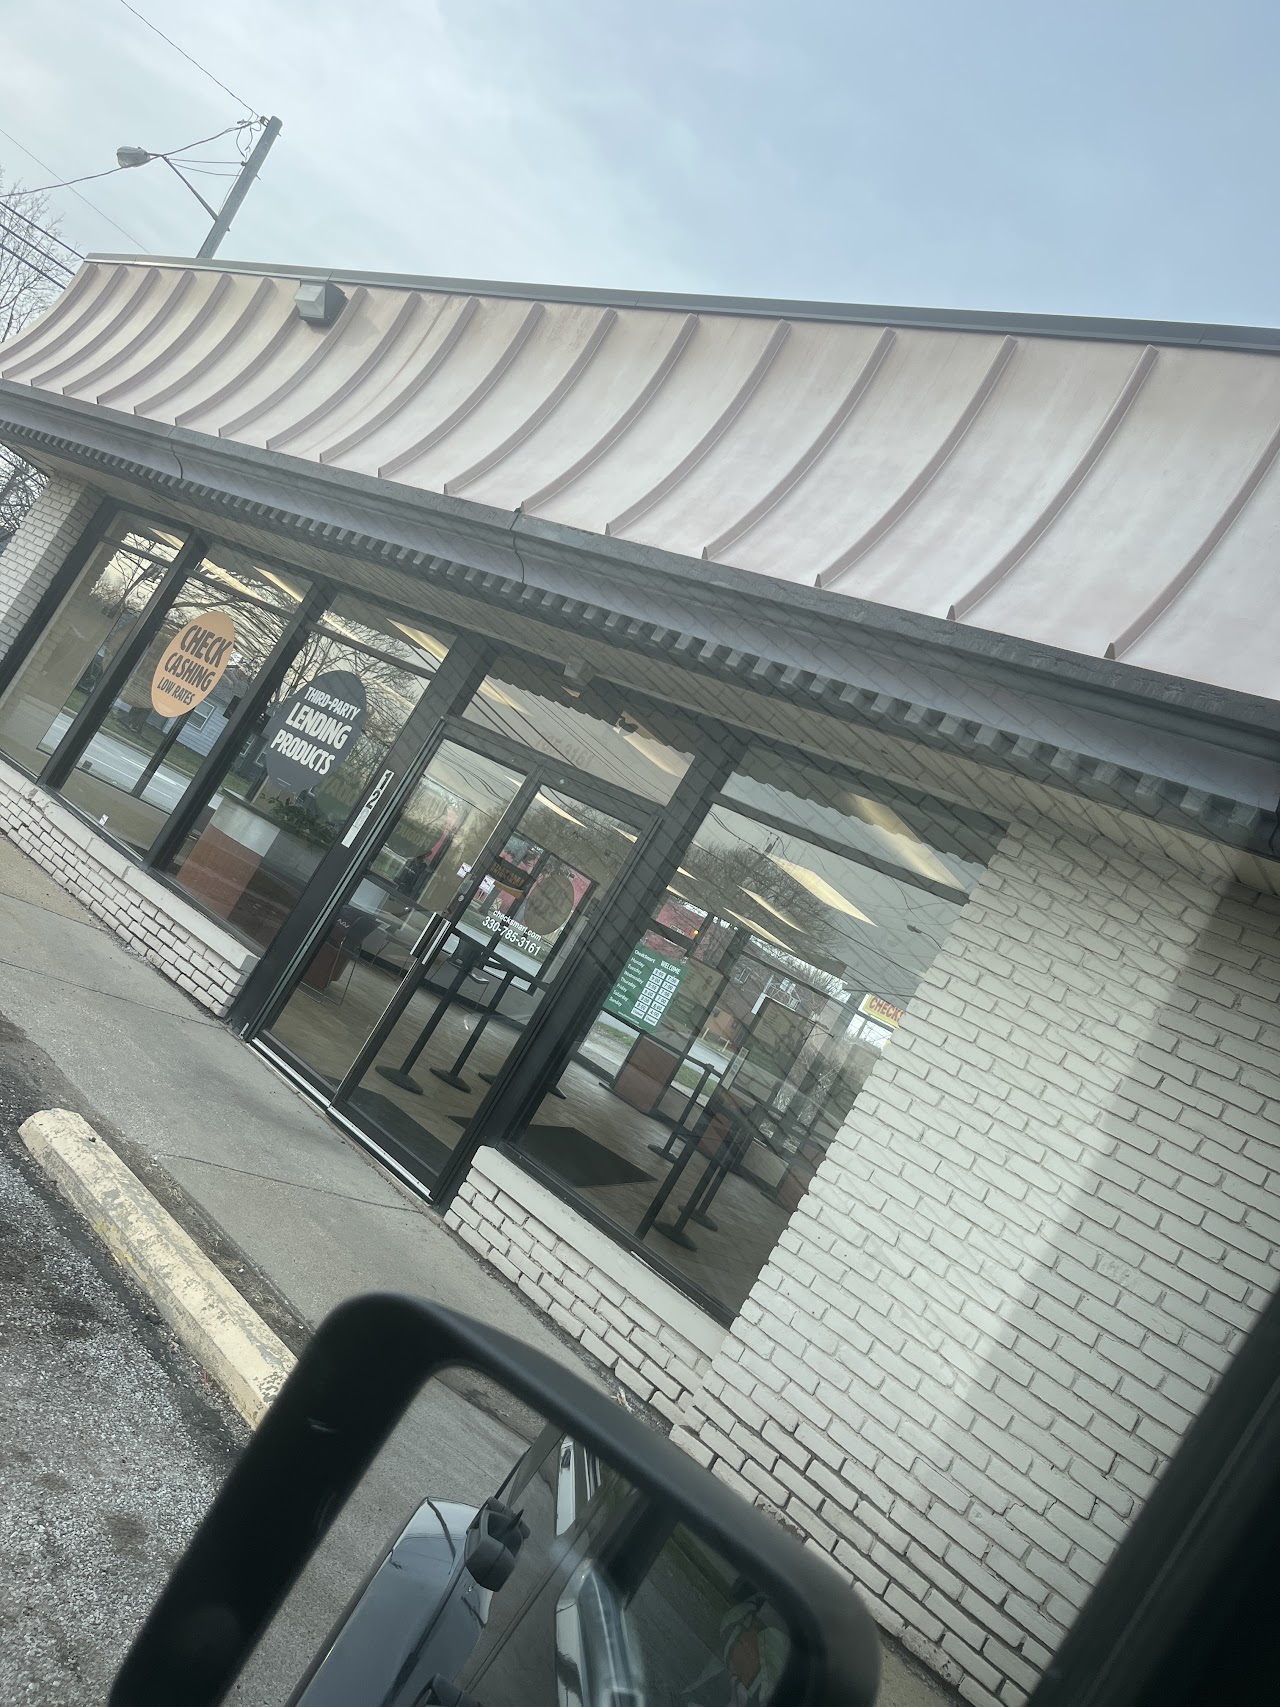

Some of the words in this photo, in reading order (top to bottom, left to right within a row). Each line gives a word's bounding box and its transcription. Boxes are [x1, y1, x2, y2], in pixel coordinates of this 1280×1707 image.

[181, 625, 232, 668] CHECK
[165, 652, 216, 692] CASHING
[157, 677, 175, 694] LOW
[172, 682, 195, 705] RATES
[304, 687, 360, 720] THIRD-PARTY
[286, 702, 352, 749] LENDING
[270, 729, 335, 775] PRODUCTS
[482, 916, 541, 956] 330-785-3161
[493, 910, 541, 941] checksmart.com
[627, 964, 642, 975] Tuesday
[631, 957, 645, 968] Monday
[660, 960, 681, 975] WELCOME
[620, 977, 637, 989] Thursday
[623, 970, 644, 984] Wednesday
[613, 989, 629, 1002] Saturday
[616, 983, 627, 993] Friday
[609, 996, 622, 1007] Sunday
